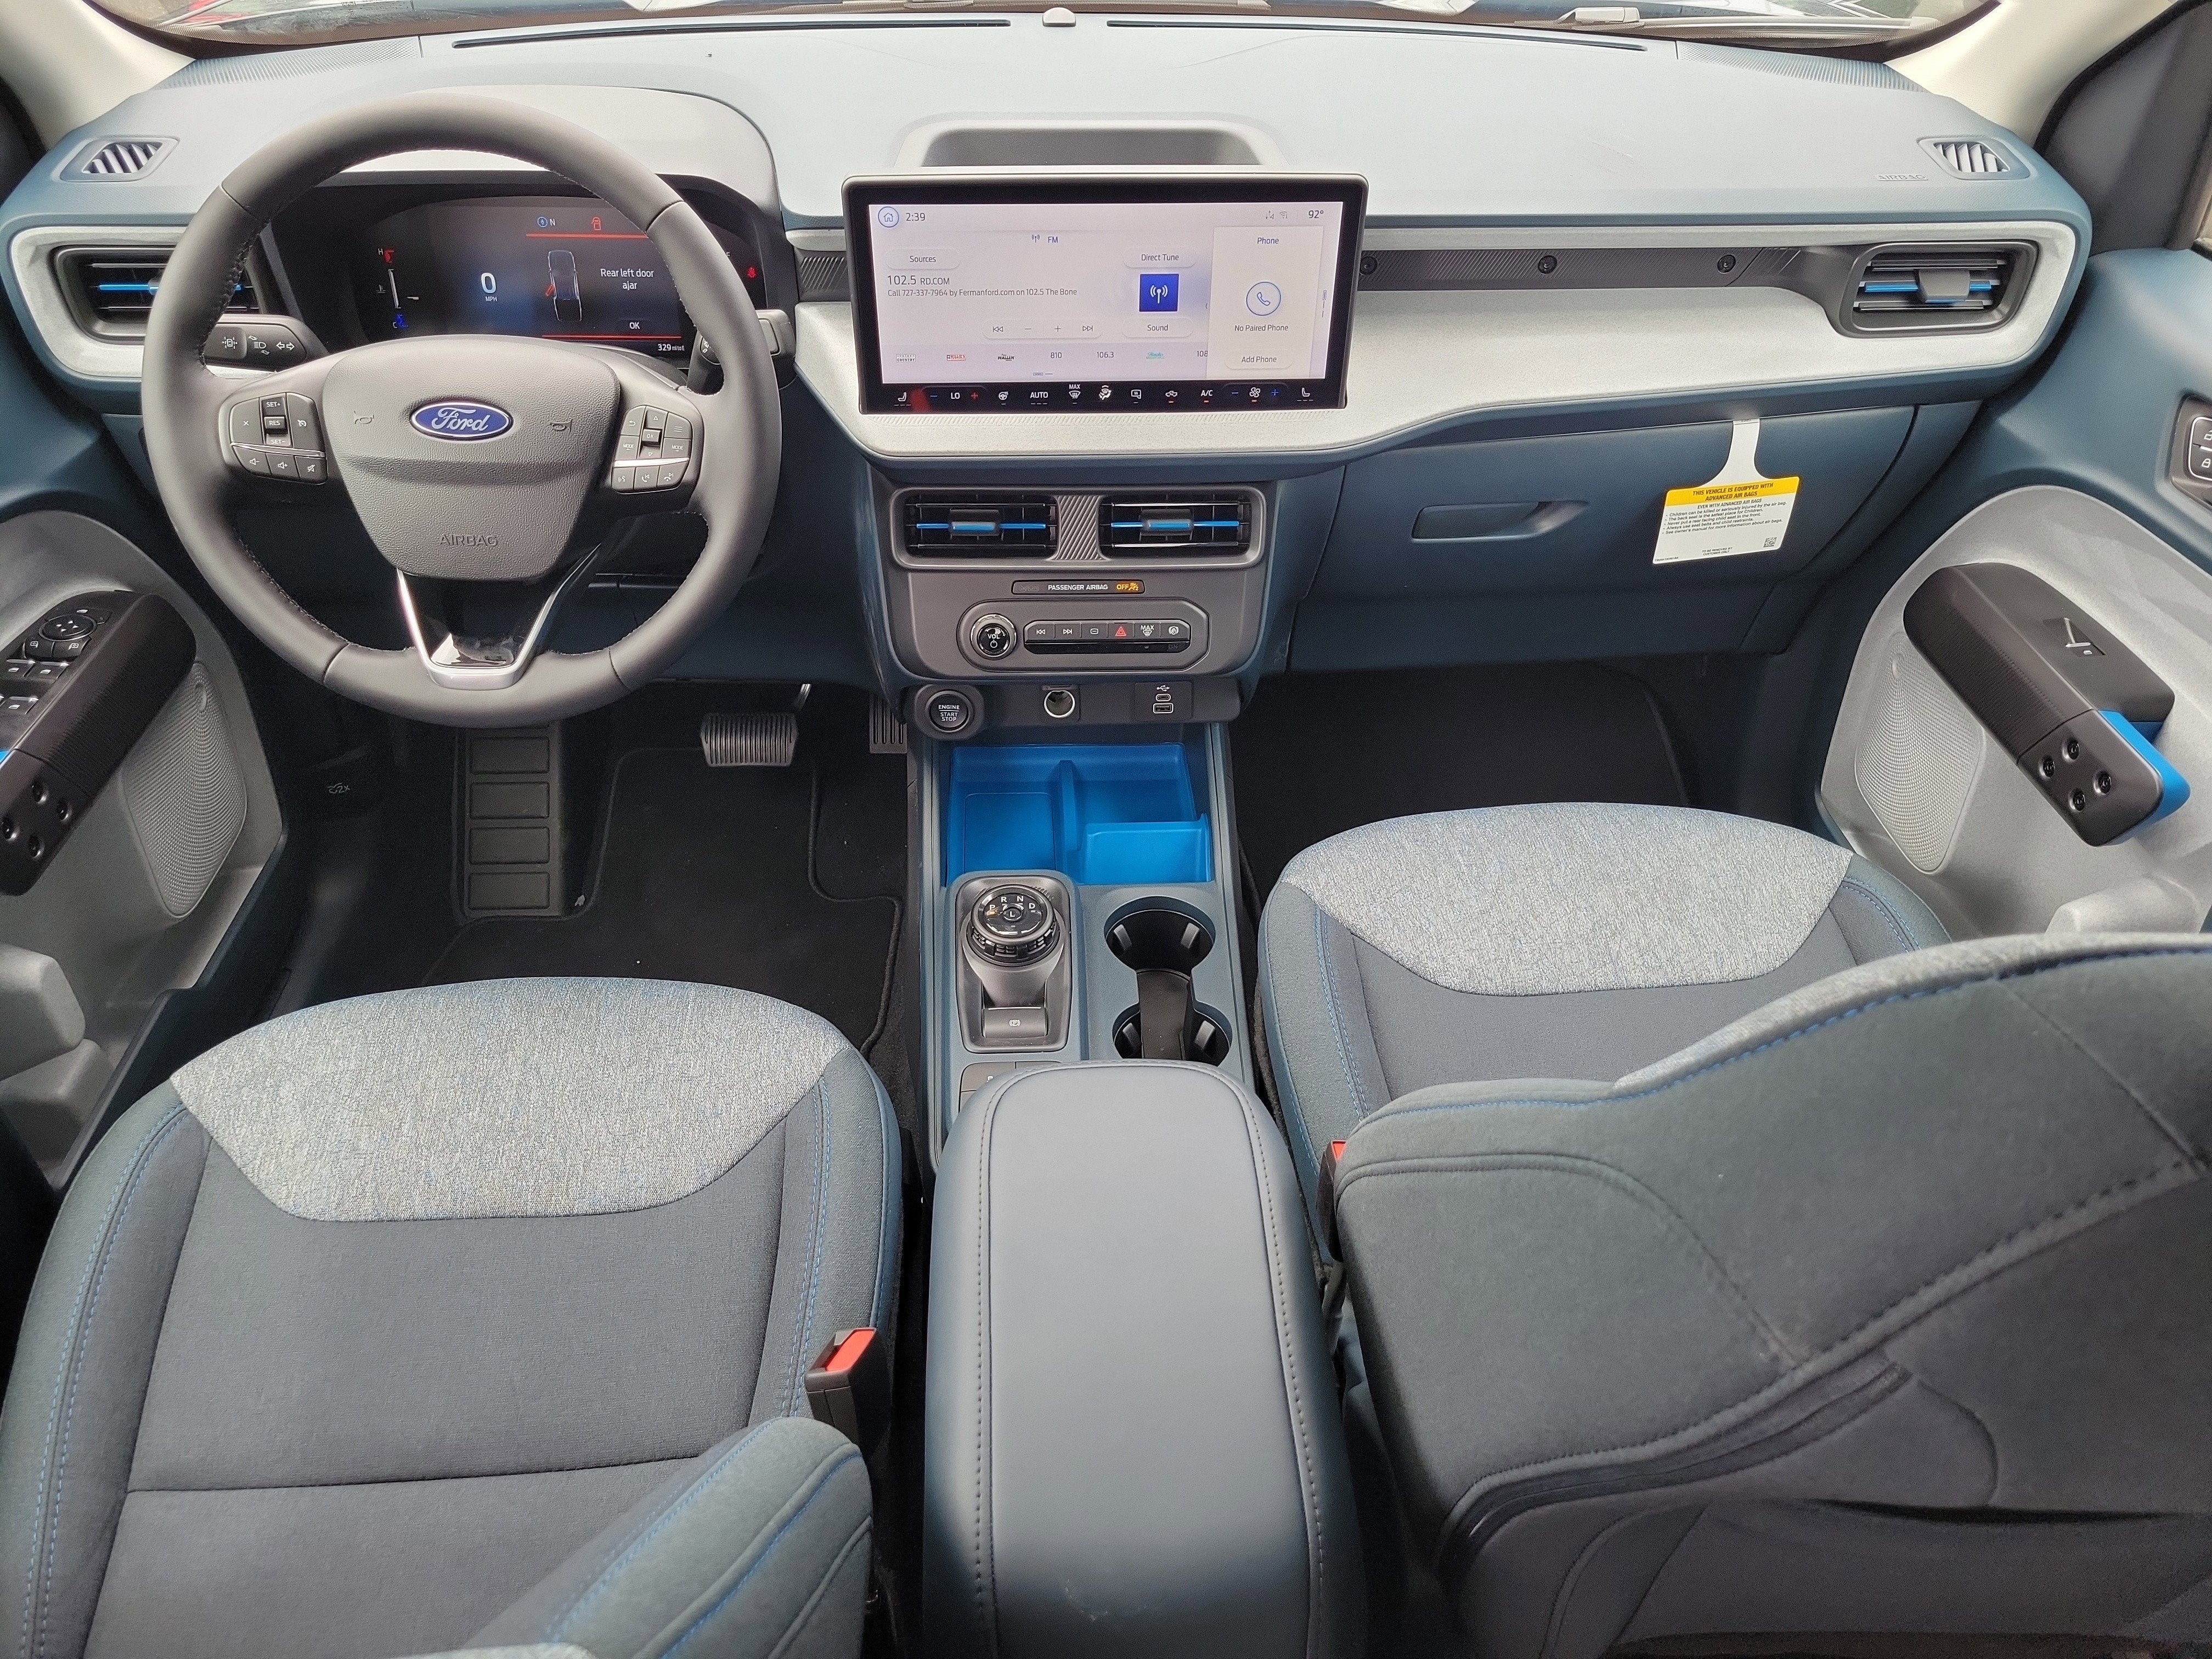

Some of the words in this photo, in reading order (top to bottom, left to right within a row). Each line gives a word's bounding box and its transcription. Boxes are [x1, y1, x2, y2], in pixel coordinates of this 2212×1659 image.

[906, 213, 926, 222] 2:39
[600, 268, 619, 277] Rear
[620, 268, 635, 277] left
[636, 268, 654, 277] door
[481, 273, 496, 294] 0
[887, 275, 916, 285] 102.5
[622, 281, 637, 291] ajar
[431, 407, 491, 432] Ford
[439, 534, 498, 546] AIRBAG
